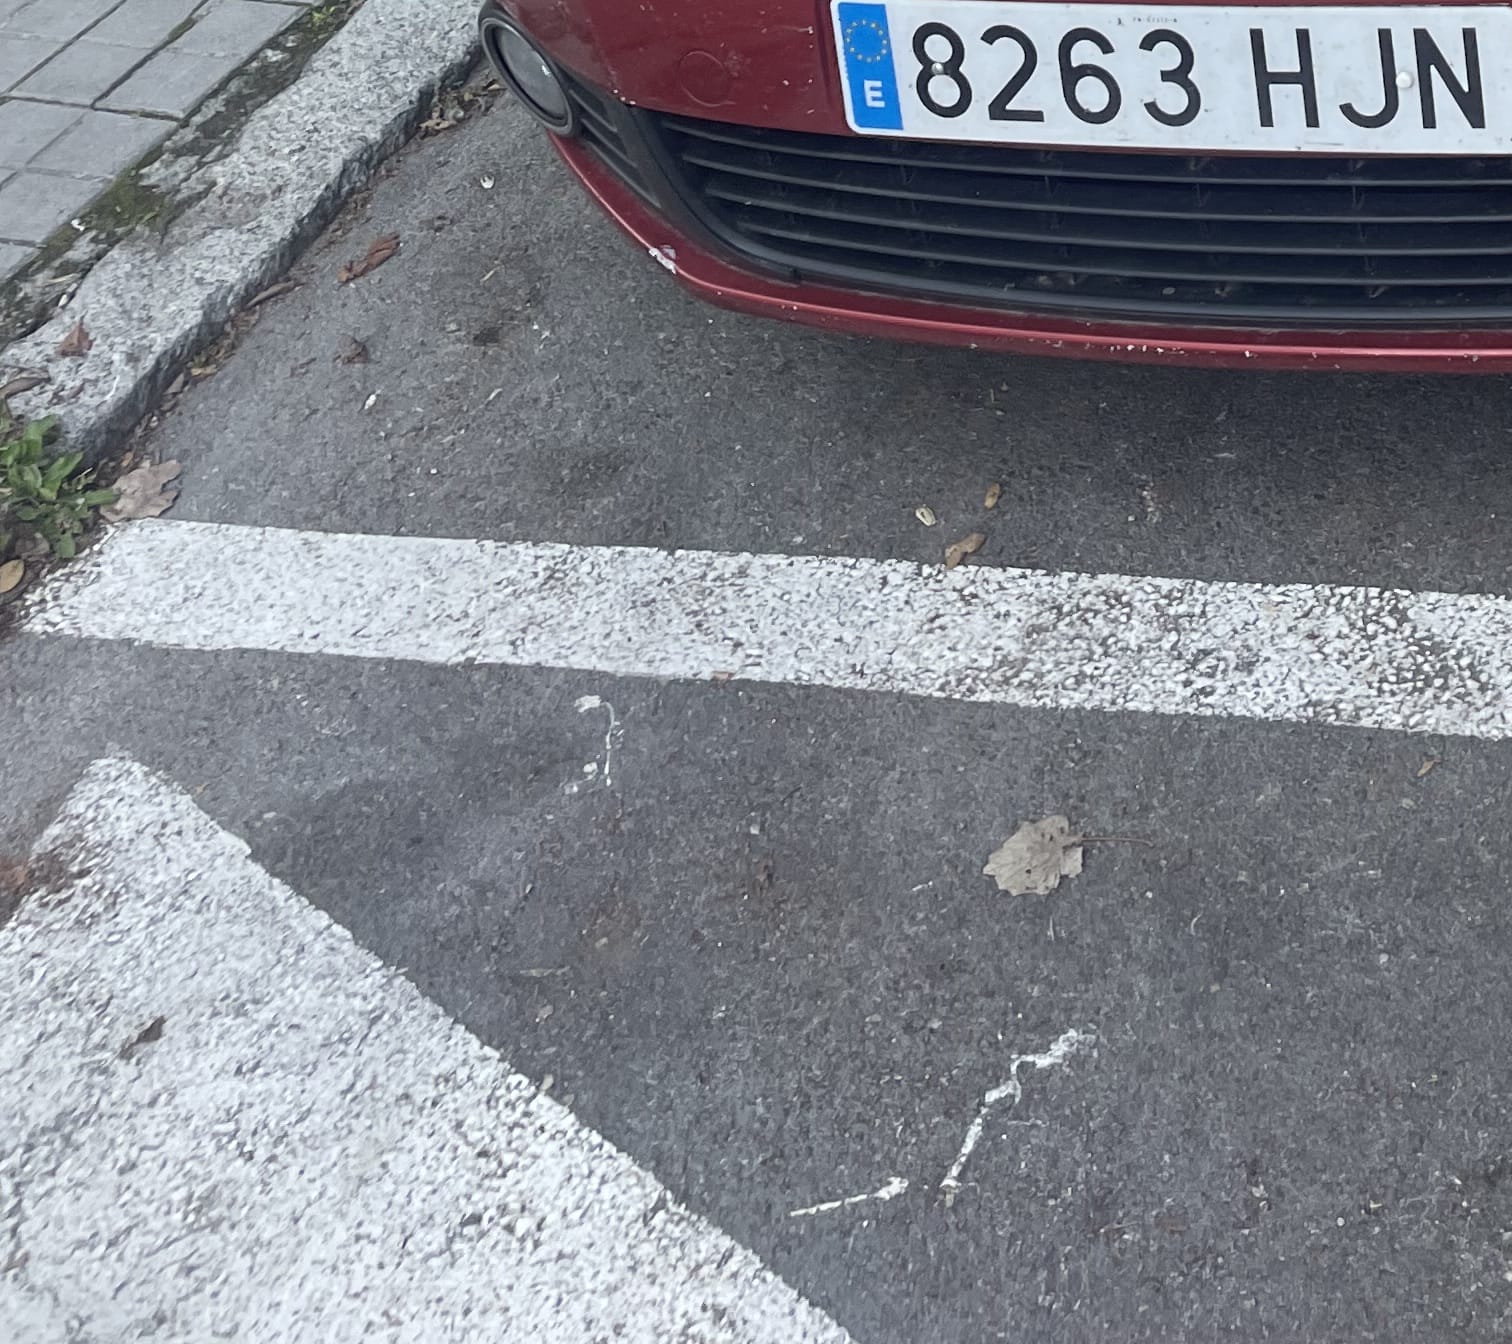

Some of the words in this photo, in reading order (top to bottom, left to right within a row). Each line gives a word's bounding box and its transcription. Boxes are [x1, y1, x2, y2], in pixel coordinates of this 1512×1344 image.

[863, 79, 886, 108] E
[911, 21, 1202, 128] 8263
[1249, 26, 1487, 130] HJN
